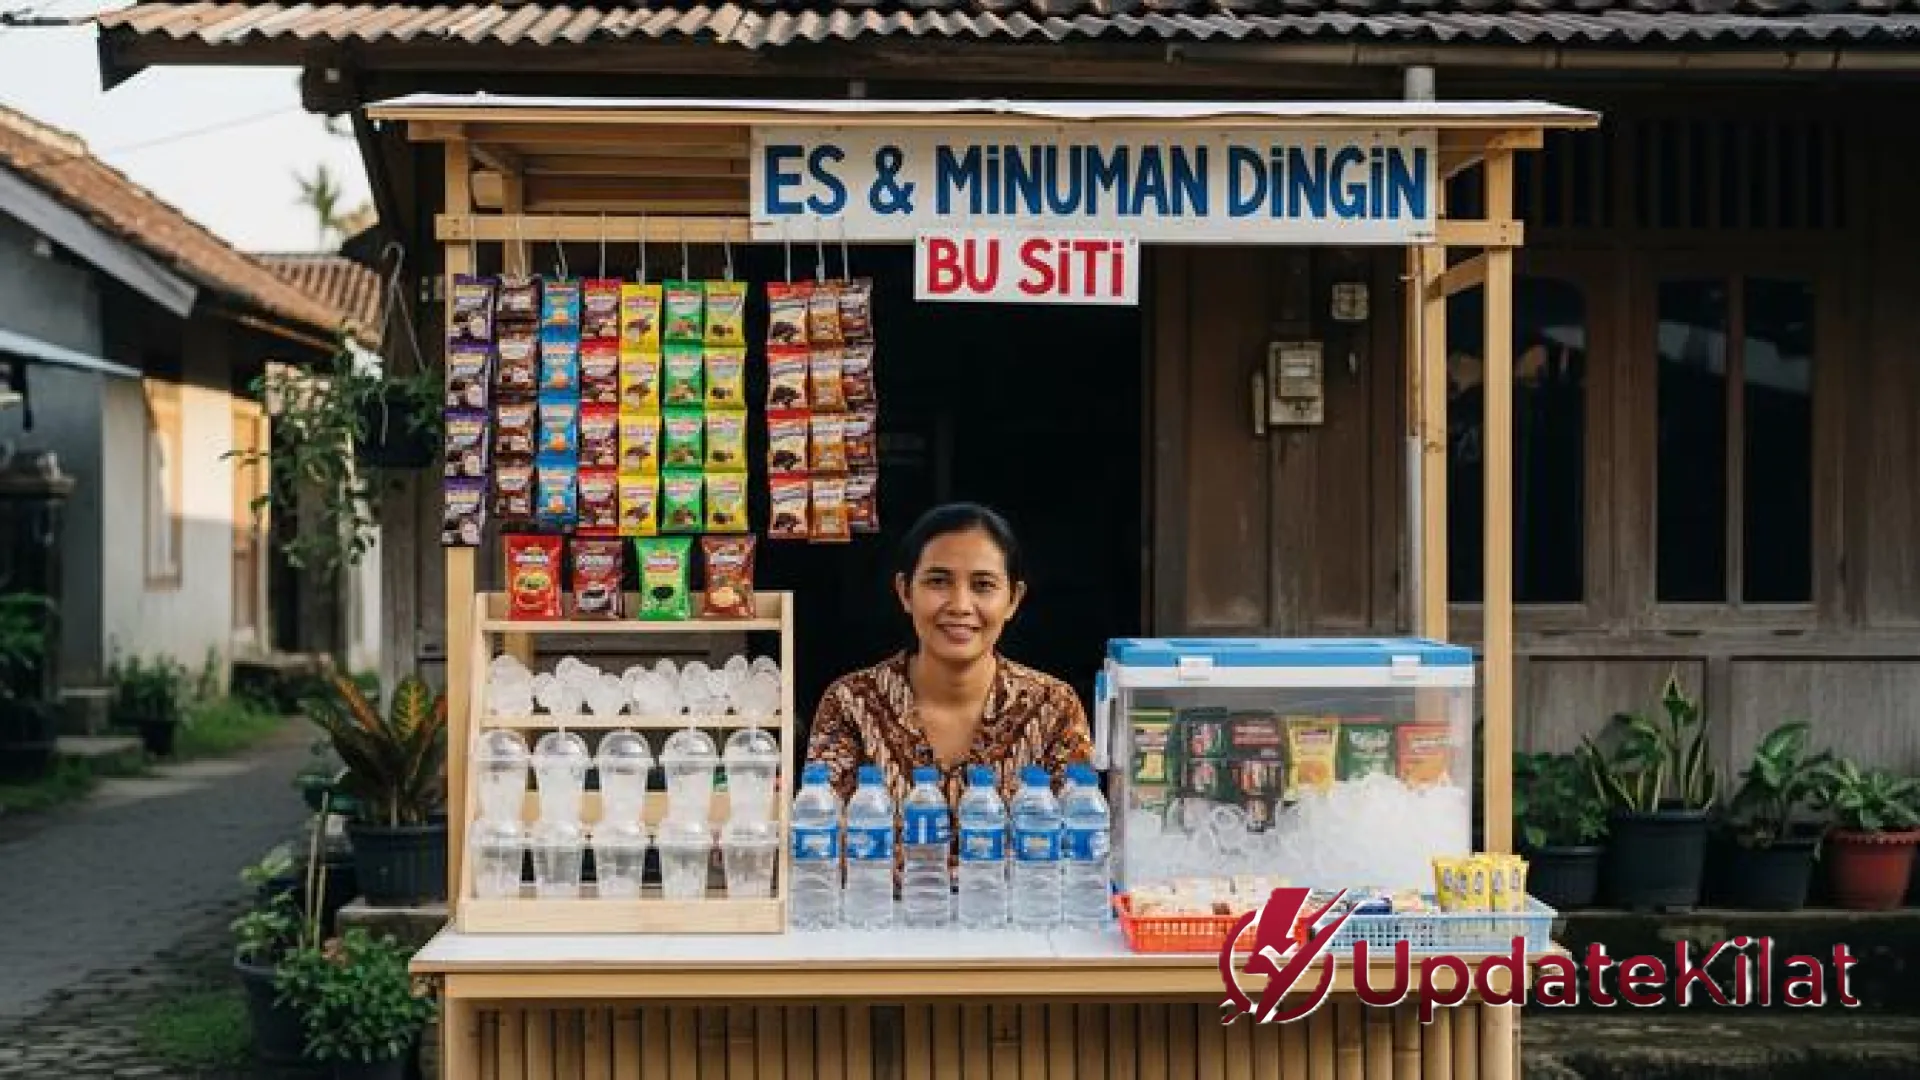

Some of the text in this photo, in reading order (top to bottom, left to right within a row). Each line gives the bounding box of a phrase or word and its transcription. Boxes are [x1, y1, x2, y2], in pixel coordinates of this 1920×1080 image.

[764, 145, 847, 215] ES
[869, 145, 914, 214] &
[926, 239, 999, 295] BU
